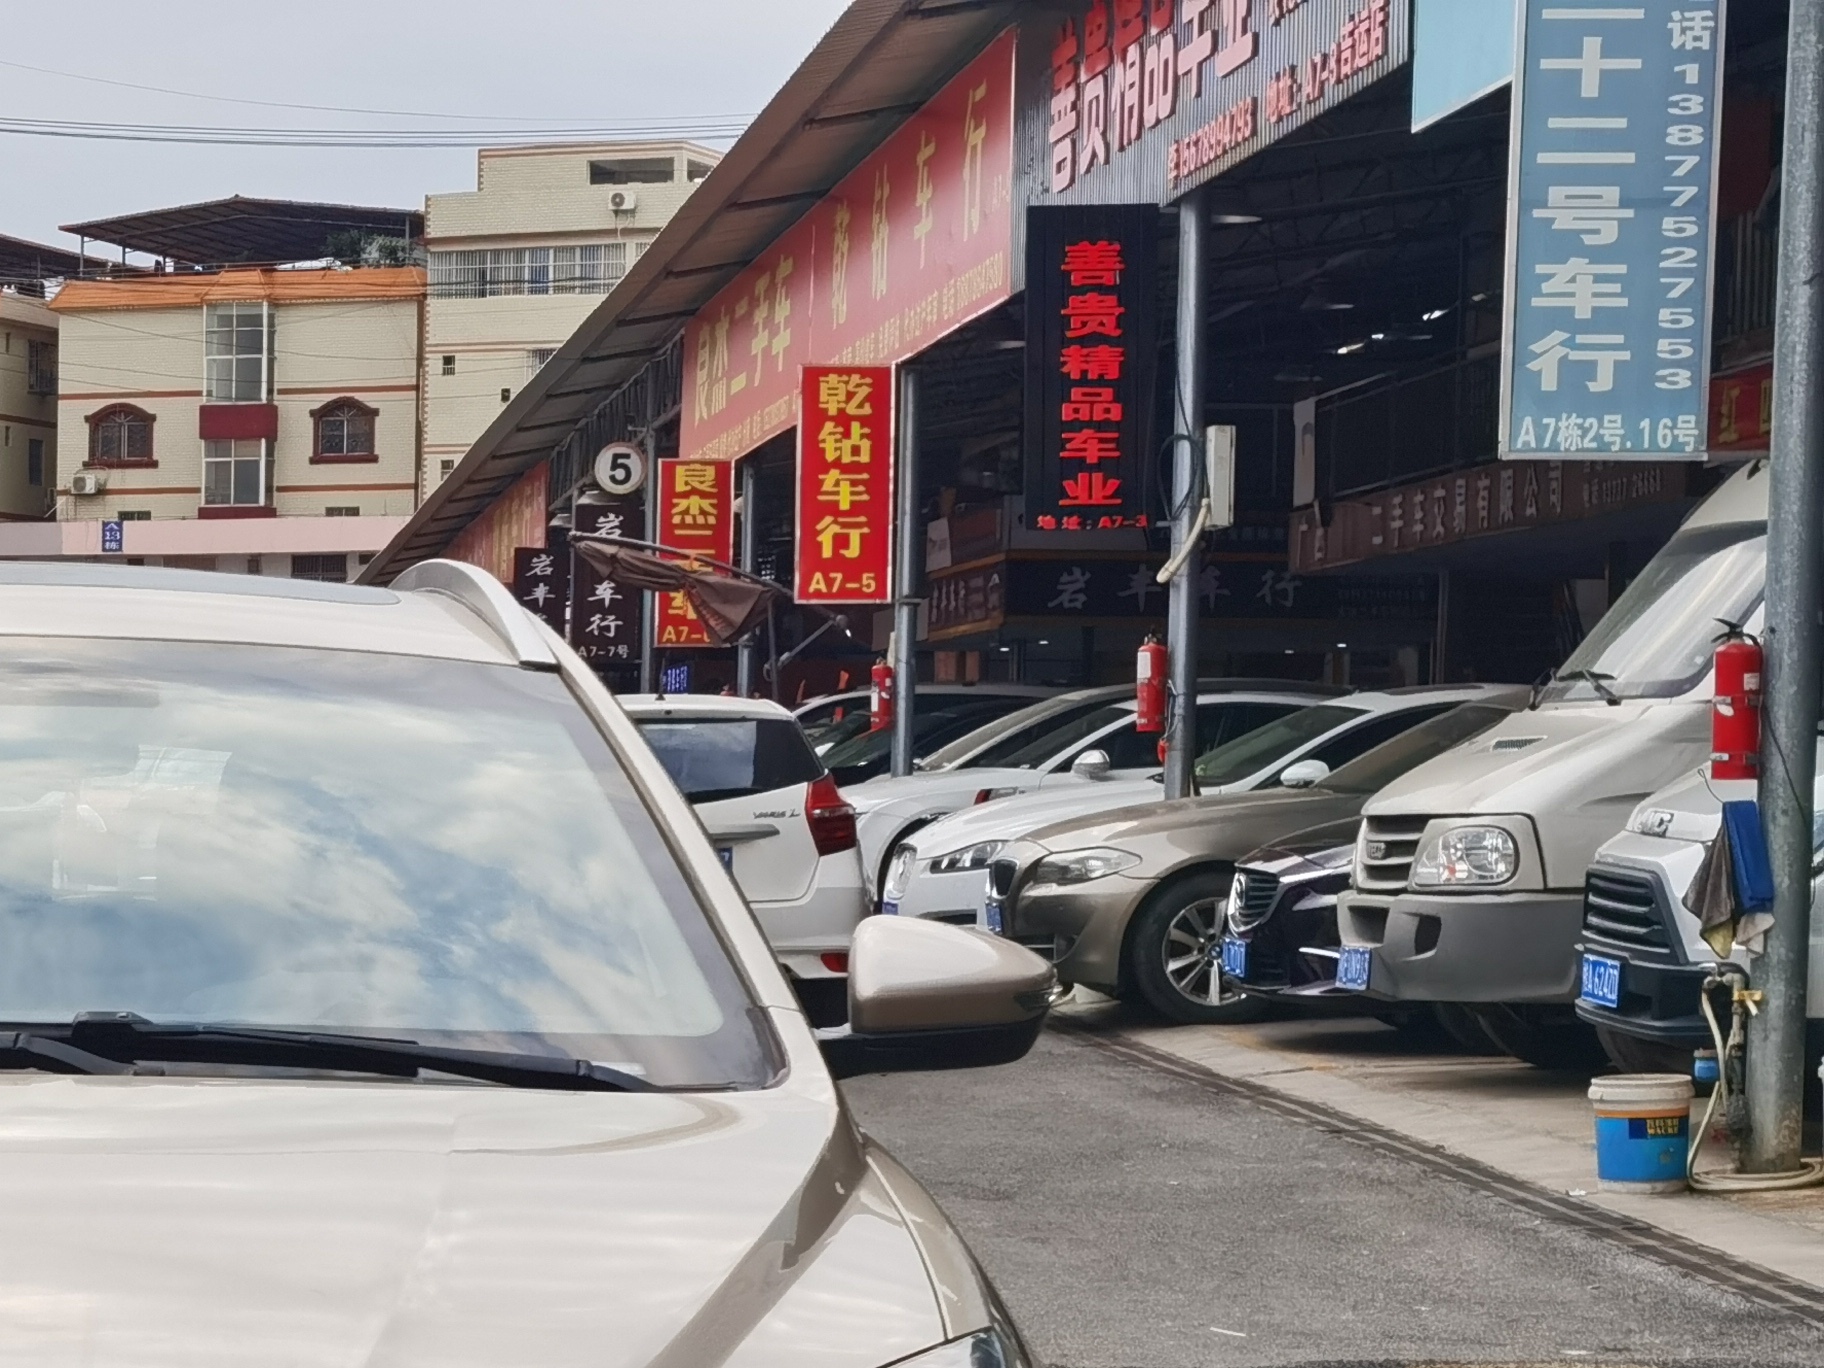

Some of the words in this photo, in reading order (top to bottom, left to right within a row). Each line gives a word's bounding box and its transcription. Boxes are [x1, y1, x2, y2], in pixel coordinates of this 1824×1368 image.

[1654, 0, 1716, 390] 话13877527553
[1059, 241, 1126, 506] 善贵精品车业
[608, 453, 633, 486] 5
[815, 373, 873, 559] 乾钻车行
[584, 513, 626, 638] 岩车行
[808, 572, 876, 593] A7-5
